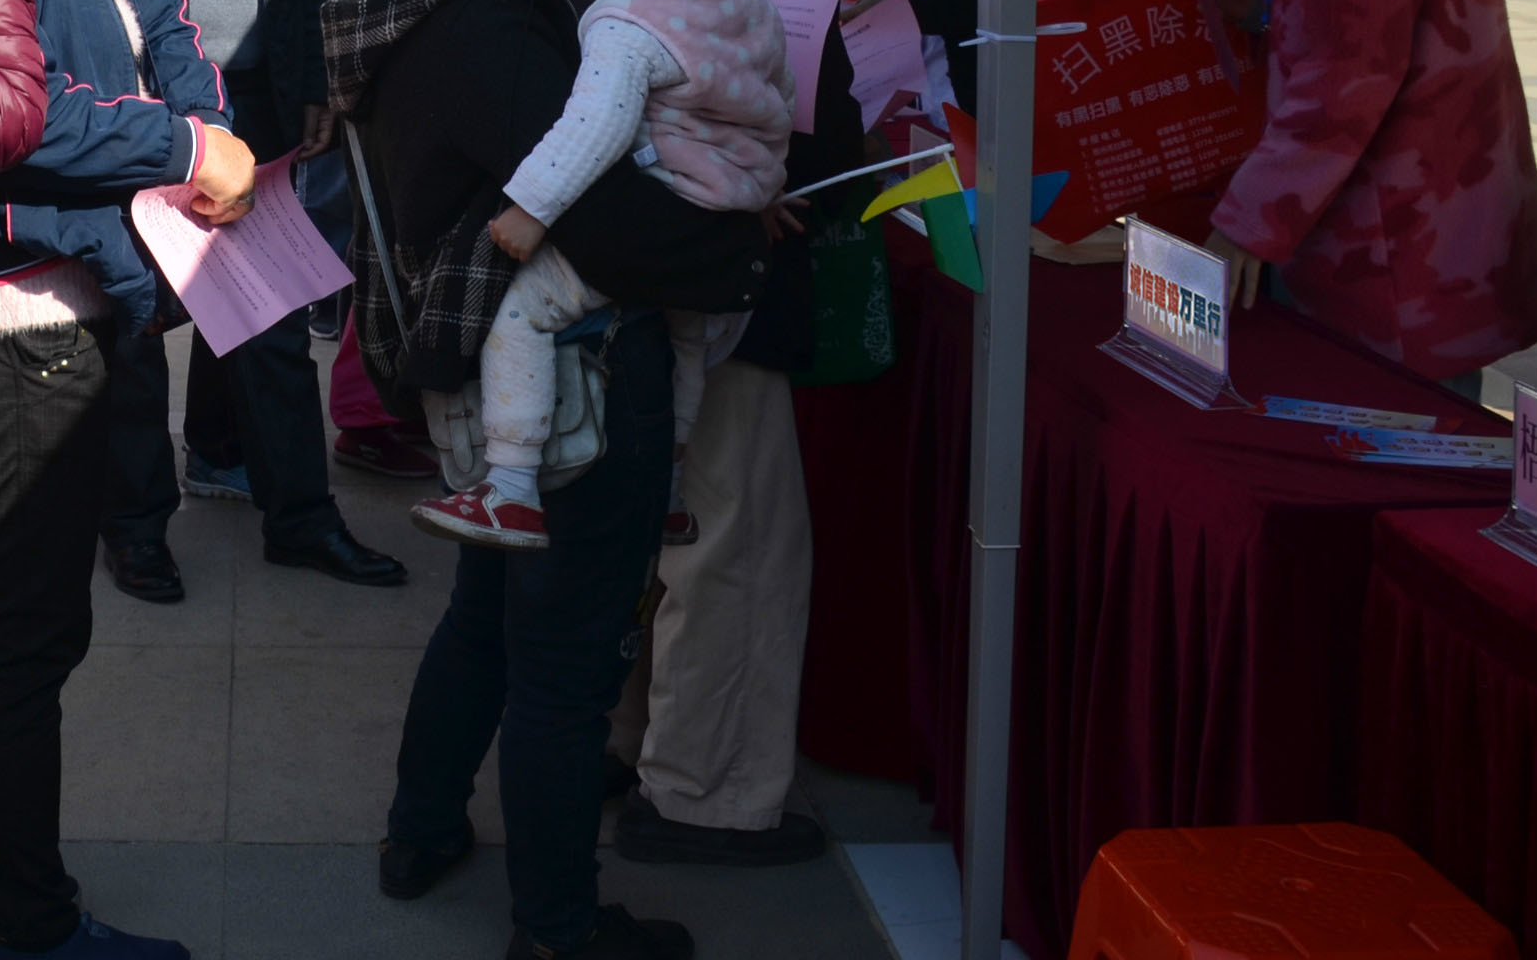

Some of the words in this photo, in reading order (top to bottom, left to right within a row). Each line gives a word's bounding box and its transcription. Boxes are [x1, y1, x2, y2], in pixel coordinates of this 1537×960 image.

[1129, 262, 1222, 337] 诚信建设万里行
